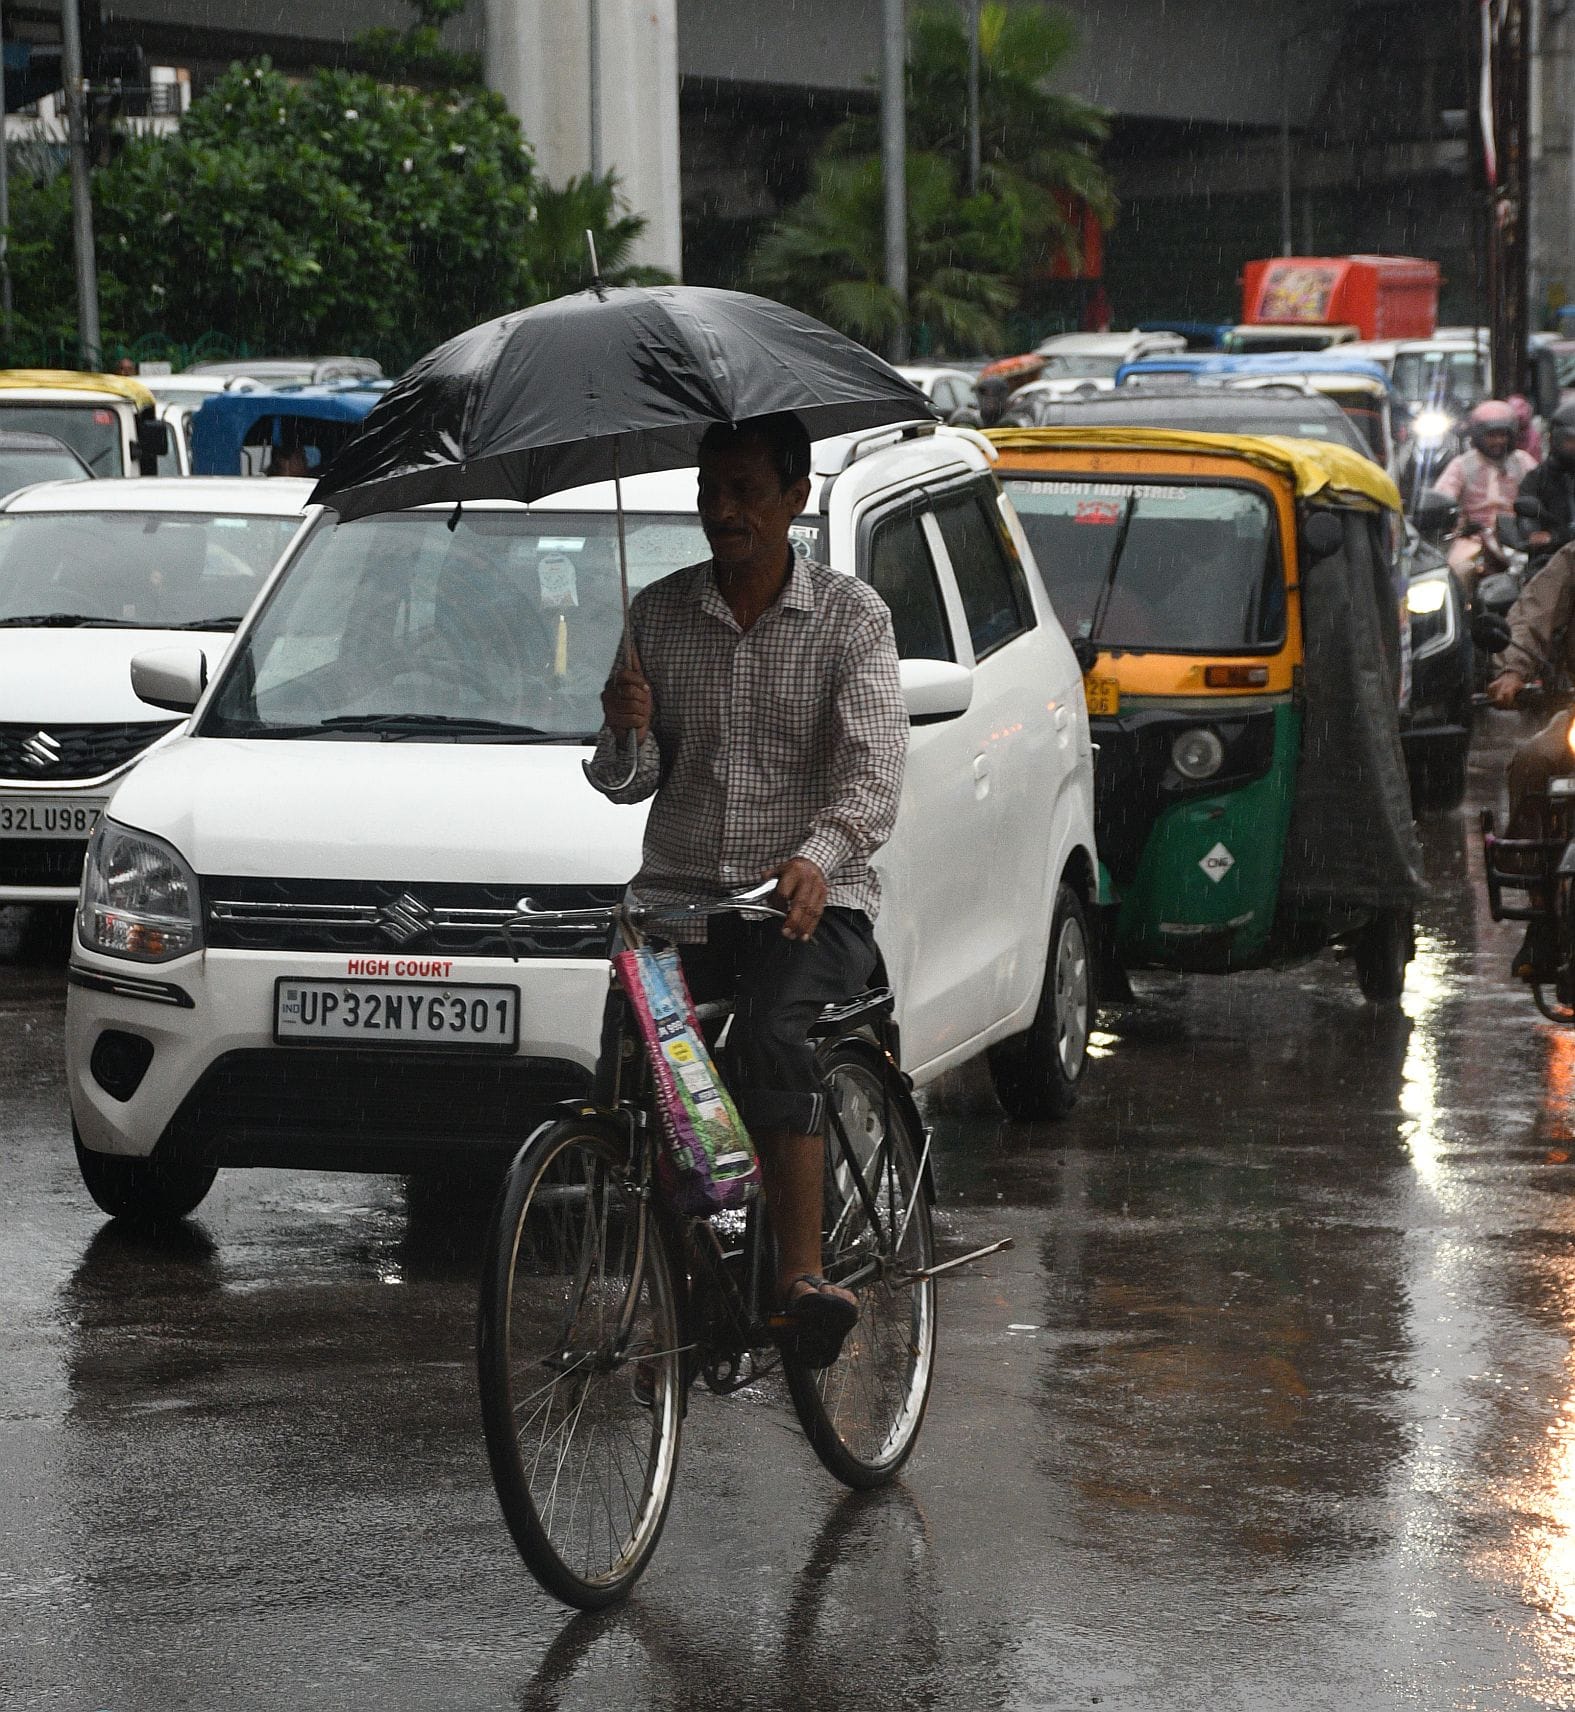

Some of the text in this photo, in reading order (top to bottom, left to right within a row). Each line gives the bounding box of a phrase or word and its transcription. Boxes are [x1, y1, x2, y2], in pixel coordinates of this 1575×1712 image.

[1032, 482, 1186, 500] BRIGHT INDUSTRIES
[1, 808, 101, 831] 32LU987
[347, 959, 453, 977] HIGH COURT
[282, 1004, 300, 1014] IND
[301, 991, 508, 1035] UP32NY6301
